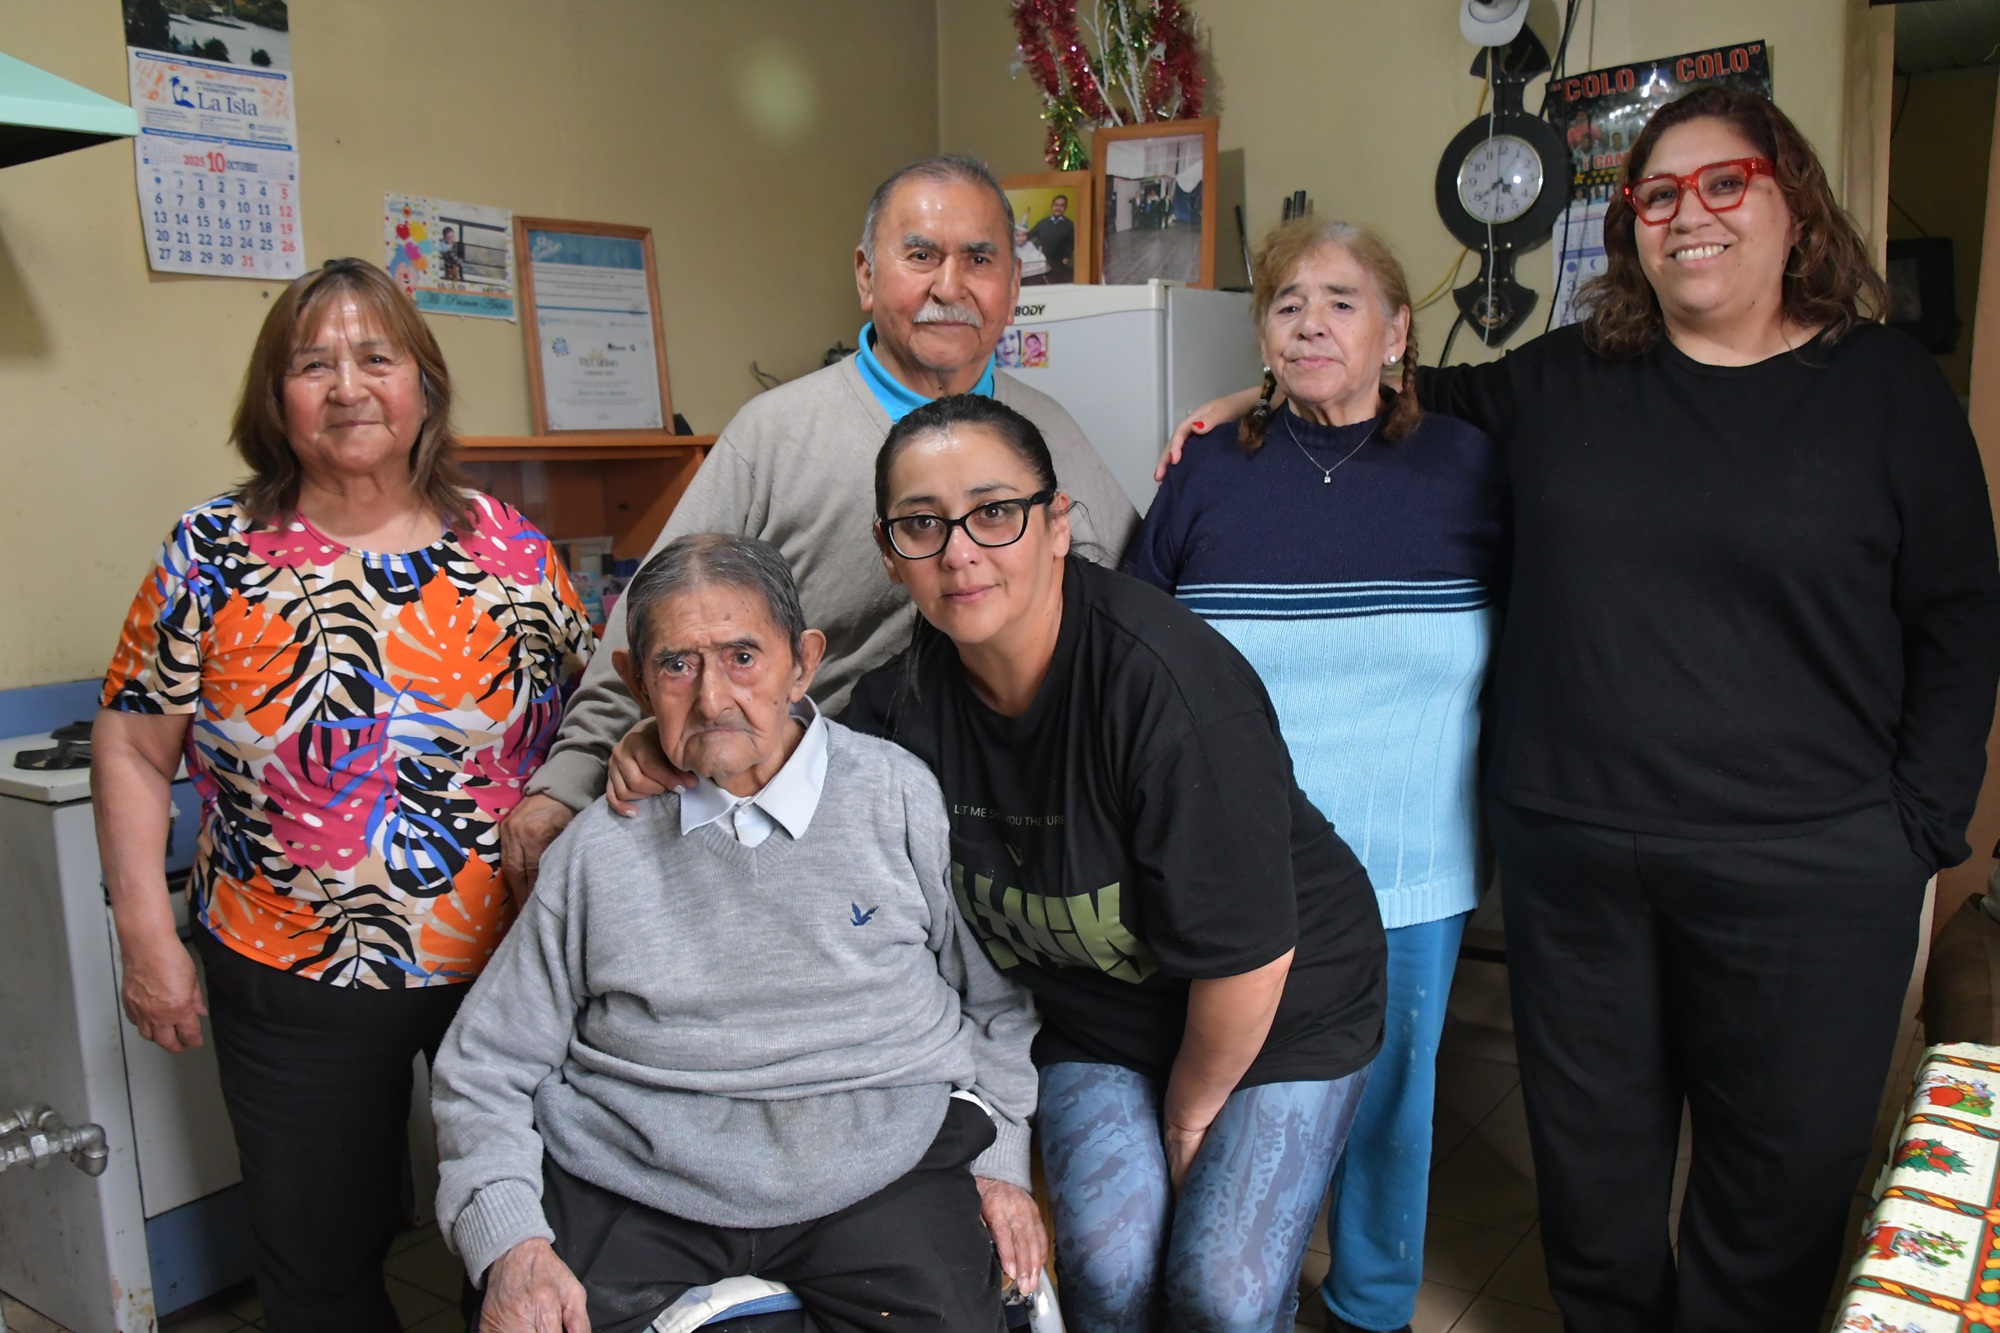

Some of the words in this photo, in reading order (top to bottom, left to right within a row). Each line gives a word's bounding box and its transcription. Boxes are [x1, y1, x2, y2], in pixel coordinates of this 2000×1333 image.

[198, 92, 222, 112] La
[226, 97, 259, 117] Isla
[1499, 146, 1508, 155] 12
[1516, 149, 1520, 158] 1
[183, 154, 205, 168] 2025
[206, 151, 226, 173] 10
[1524, 160, 1531, 169] 2
[1475, 163, 1486, 172] 10
[1469, 177, 1477, 187] 9
[198, 179, 204, 191] 1
[218, 181, 225, 193] 2
[239, 184, 246, 195] 3
[260, 186, 267, 197] 4
[281, 188, 288, 200] 5
[1522, 189, 1528, 197] 4
[1474, 192, 1481, 201] 8
[155, 193, 162, 205] 6
[177, 194, 183, 206] 7
[198, 197, 205, 209] 8
[219, 200, 226, 211] 9
[237, 201, 250, 214] 10
[258, 204, 271, 216] 11
[279, 206, 293, 218] 12
[1483, 201, 1488, 211] 7
[1496, 204, 1504, 214] 6
[1512, 200, 1519, 209] 5
[154, 211, 168, 224] 13
[175, 213, 189, 225] 14
[197, 215, 210, 228] 15
[218, 217, 231, 230] 16
[239, 220, 251, 231] 17
[259, 222, 272, 234] 18
[281, 223, 294, 235] 19
[156, 229, 170, 242] 20
[176, 232, 190, 244] 21
[198, 234, 212, 246] 22
[219, 235, 233, 248] 23
[240, 237, 253, 249] 24
[260, 239, 274, 251] 25
[281, 241, 296, 253] 26
[158, 248, 171, 260] 27
[178, 250, 192, 262] 28
[200, 252, 213, 264] 29
[220, 254, 234, 266] 30
[241, 256, 254, 268] 31
[1015, 305, 1045, 316] BODY
[954, 804, 968, 814] LET
[970, 807, 987, 818] ME
[1025, 817, 1042, 826] THE
